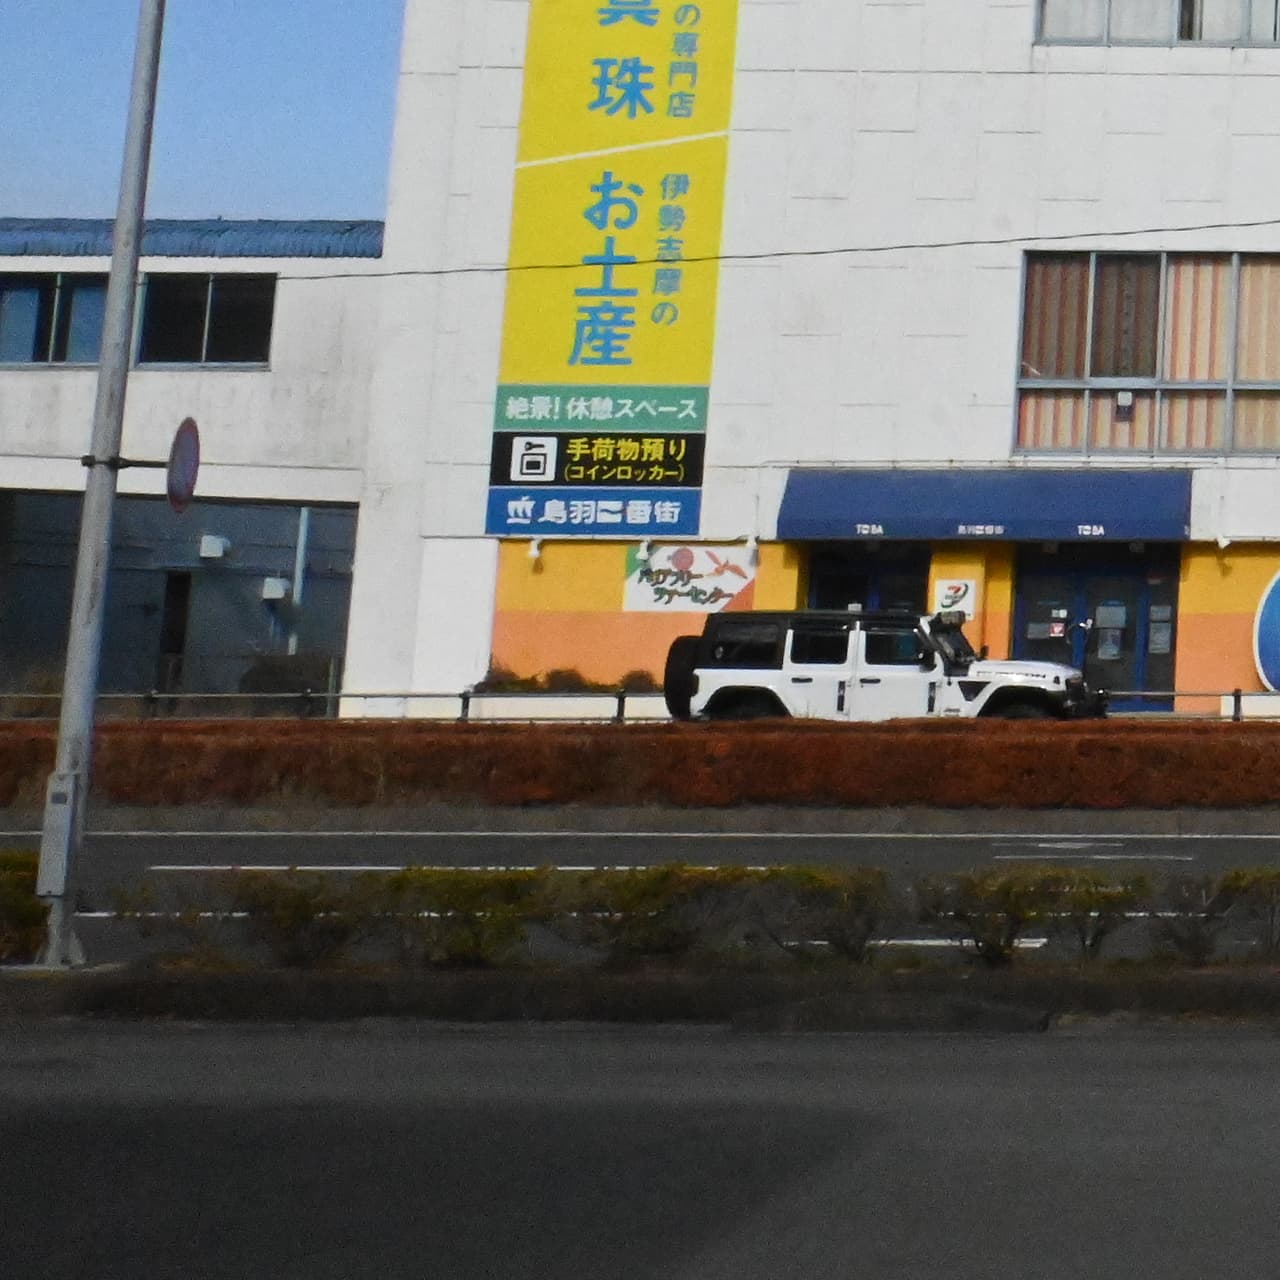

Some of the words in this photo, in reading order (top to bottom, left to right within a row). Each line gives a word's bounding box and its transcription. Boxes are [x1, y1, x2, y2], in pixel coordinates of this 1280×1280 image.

[567, 170, 646, 367] お土産
[650, 172, 691, 327] 伊勢志摩の
[565, 396, 698, 421] 休憩スペース
[566, 436, 688, 463] 手荷物預り
